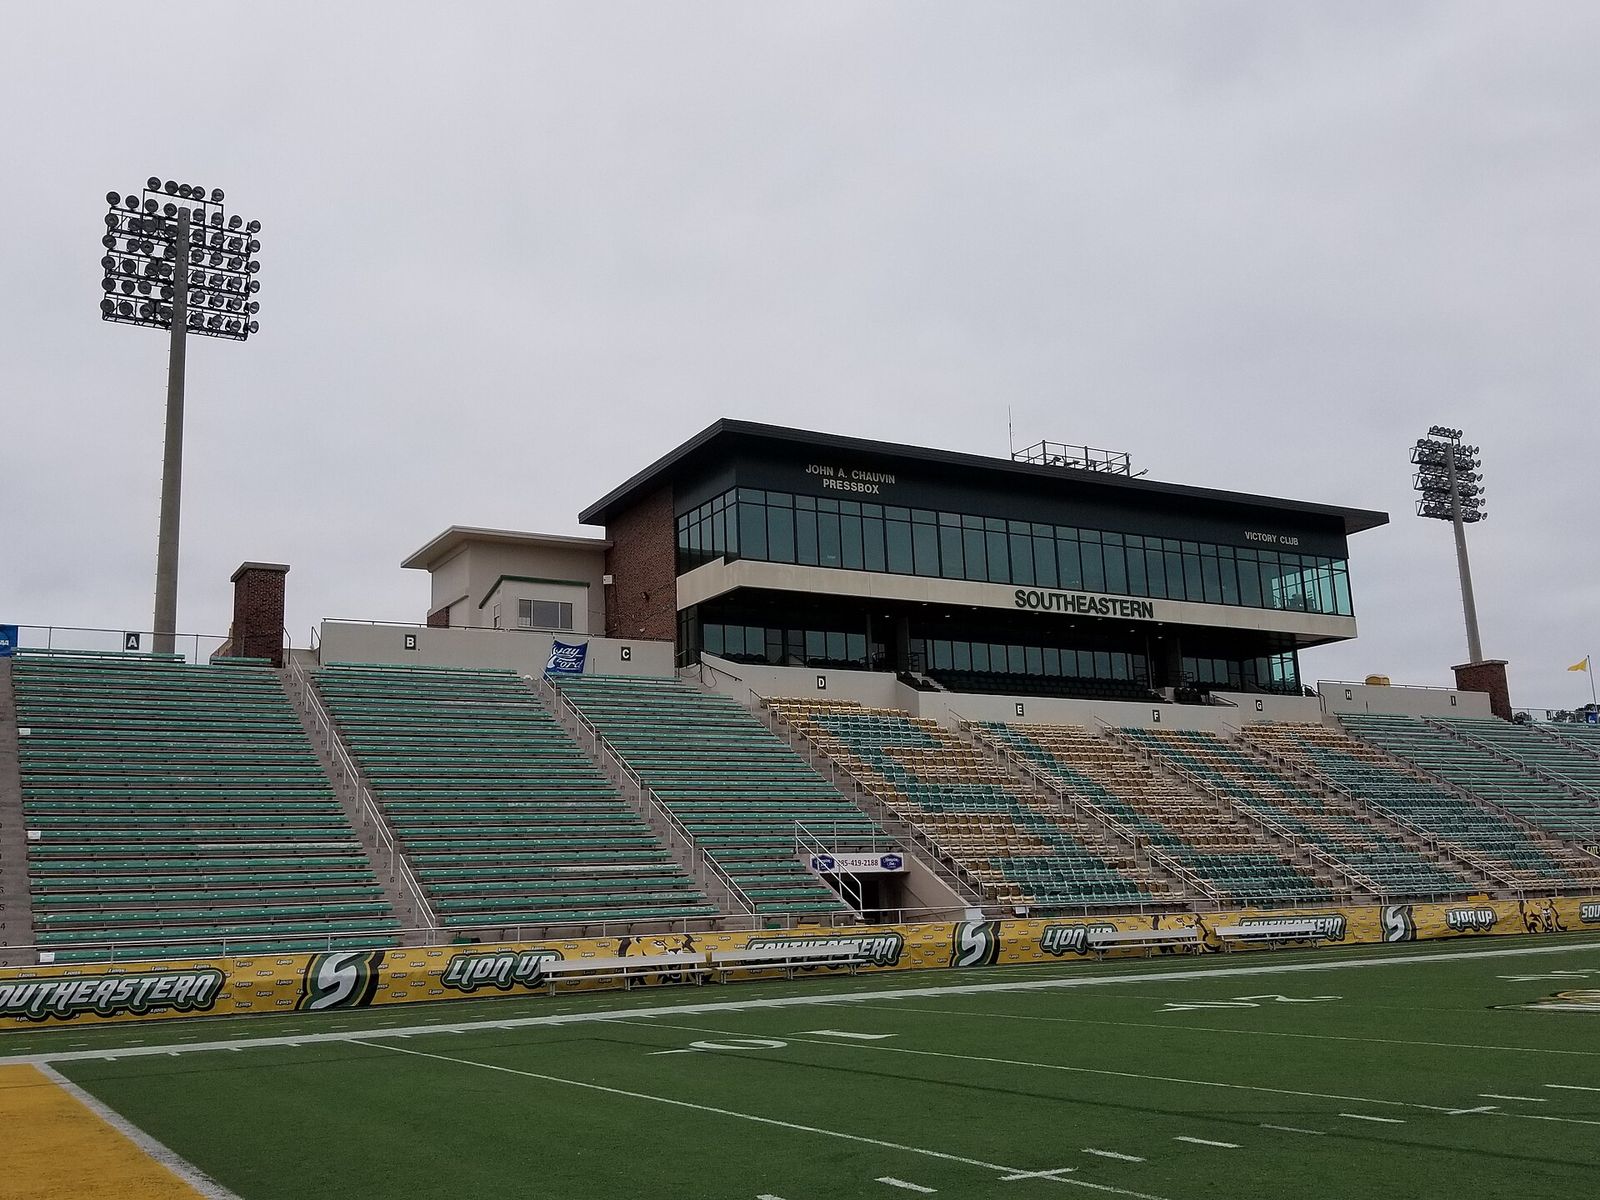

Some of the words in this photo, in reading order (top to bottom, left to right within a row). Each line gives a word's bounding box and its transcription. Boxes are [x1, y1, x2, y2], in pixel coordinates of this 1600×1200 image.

[806, 464, 834, 476] JOHN
[838, 468, 847, 478] A.
[852, 470, 895, 484] CHAUVIN
[823, 478, 880, 494] PRESSBOX
[1244, 531, 1277, 543] VICTORY
[1280, 536, 1298, 546] CLUB
[1014, 590, 1154, 618] SOUTHEASTERN
[127, 636, 138, 647] A
[407, 637, 414, 647] B
[622, 649, 629, 659] C
[1449, 911, 1476, 926] LION
[1478, 911, 1492, 926] UP
[959, 921, 988, 966] S
[1043, 929, 1084, 949] LION
[447, 958, 513, 984] LION
[309, 953, 359, 1009] S
